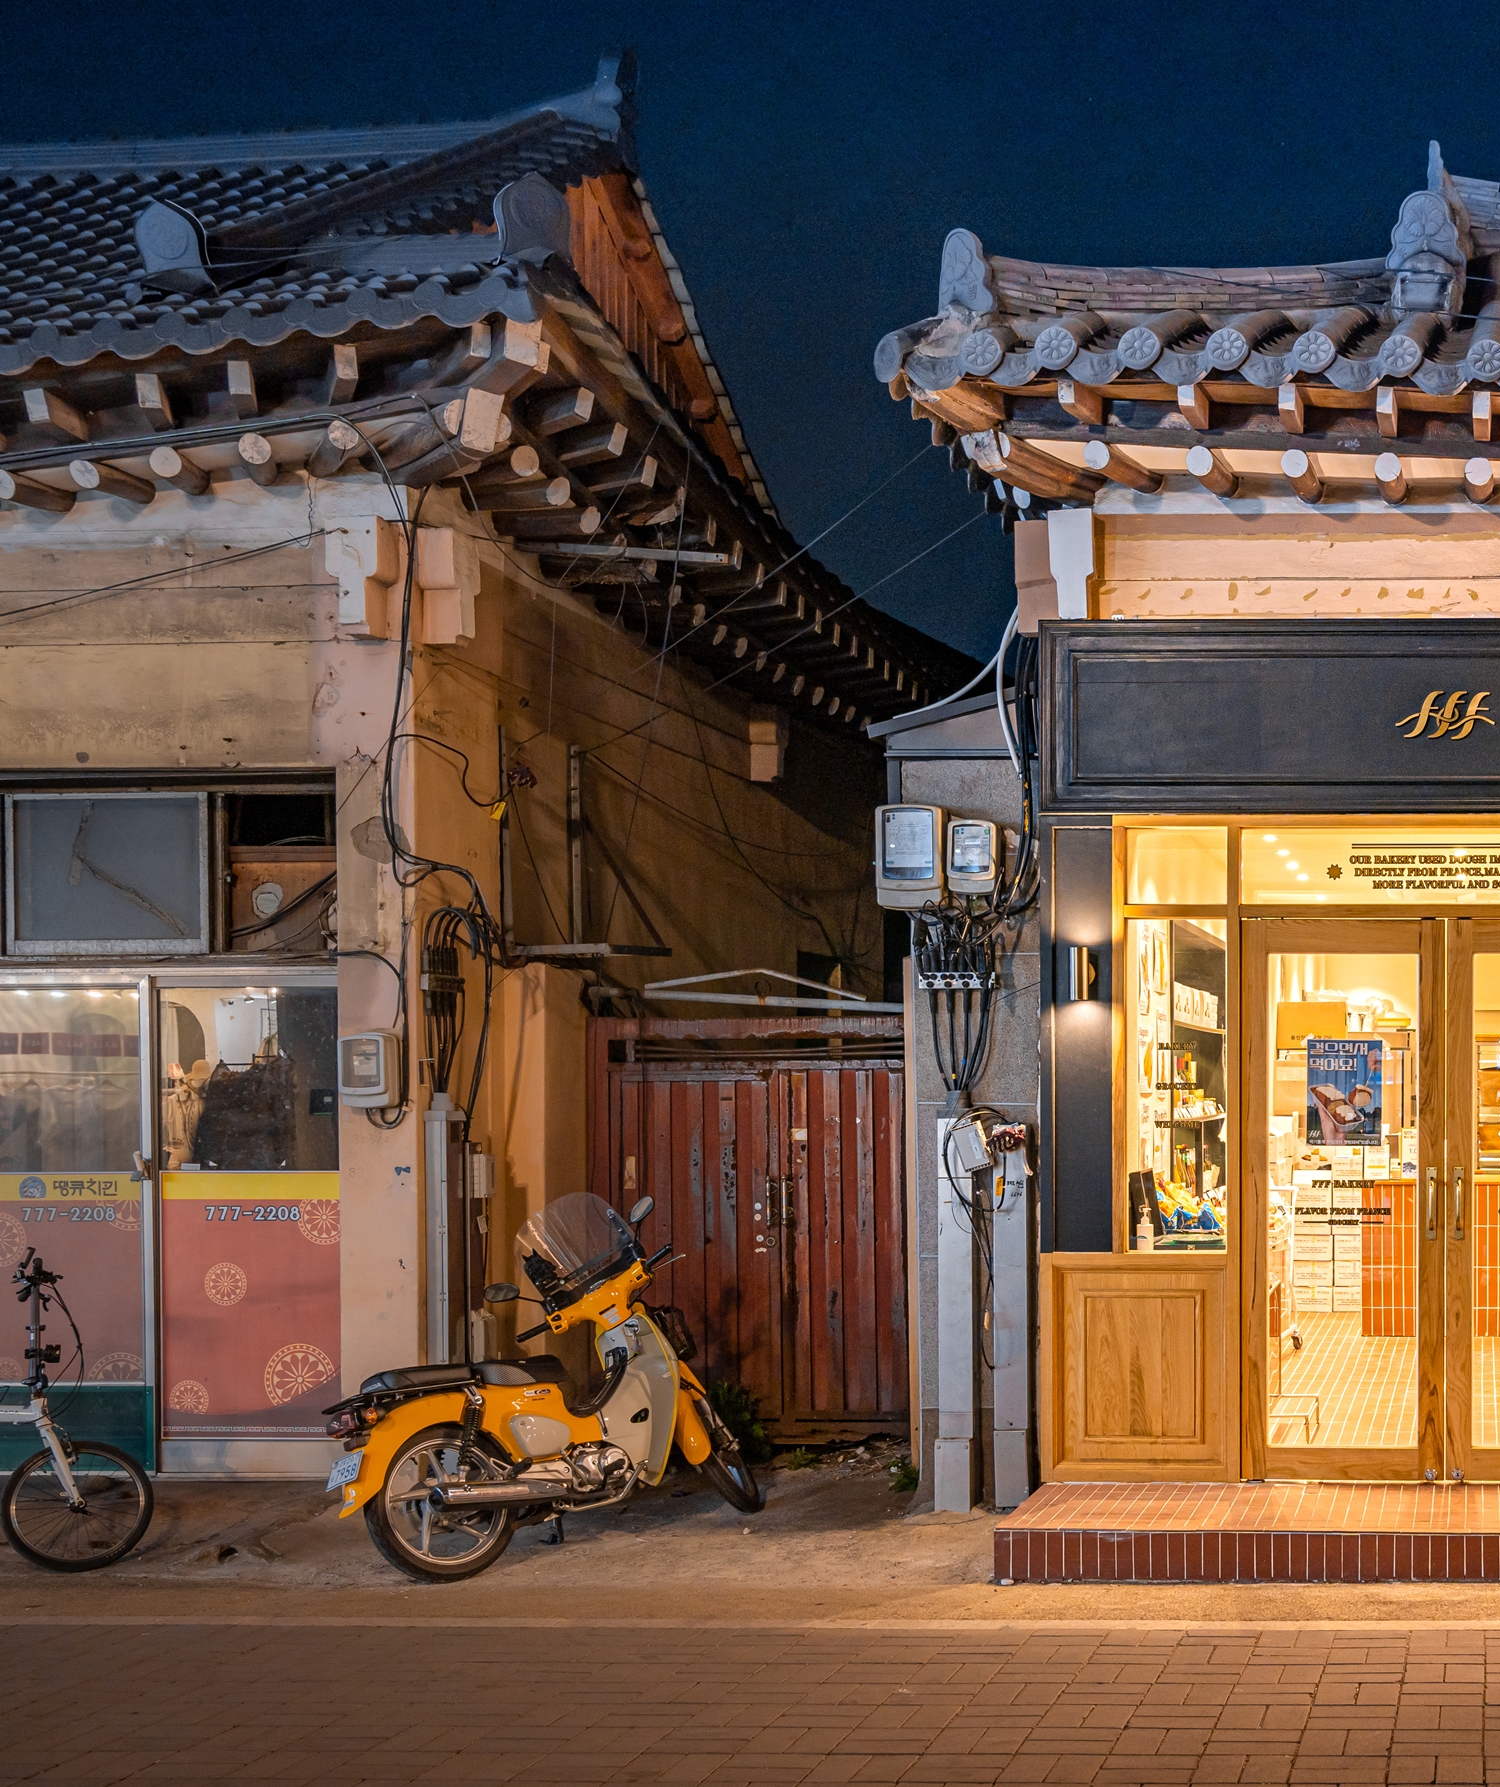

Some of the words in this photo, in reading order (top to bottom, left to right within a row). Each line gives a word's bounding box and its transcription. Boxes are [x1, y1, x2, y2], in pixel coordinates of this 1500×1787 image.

[1349, 855, 1372, 865] OUR
[1373, 855, 1417, 865] BAKERY
[1418, 855, 1447, 864] USED
[1449, 855, 1487, 864] DOUGH
[1354, 867, 1405, 877] DIRECTLY
[1407, 867, 1438, 877] FROM
[1372, 880, 1404, 889] MORE
[1405, 880, 1466, 889] FLAVORFUL
[1466, 880, 1490, 889] AND
[1309, 1058, 1357, 1071] 먹어요!
[1155, 1083, 1197, 1091] GROCERY
[53, 1178, 118, 1197] 땡큐치킨
[1311, 1180, 1331, 1188] FFF
[1333, 1180, 1376, 1188] BAKERY
[21, 1207, 117, 1222] 777-2208
[205, 1205, 301, 1221] 777-2208
[1295, 1207, 1328, 1215] FLAVOR
[1329, 1207, 1355, 1215] FROM
[1356, 1207, 1391, 1215] FRANCE
[335, 1463, 357, 1483] 7958
